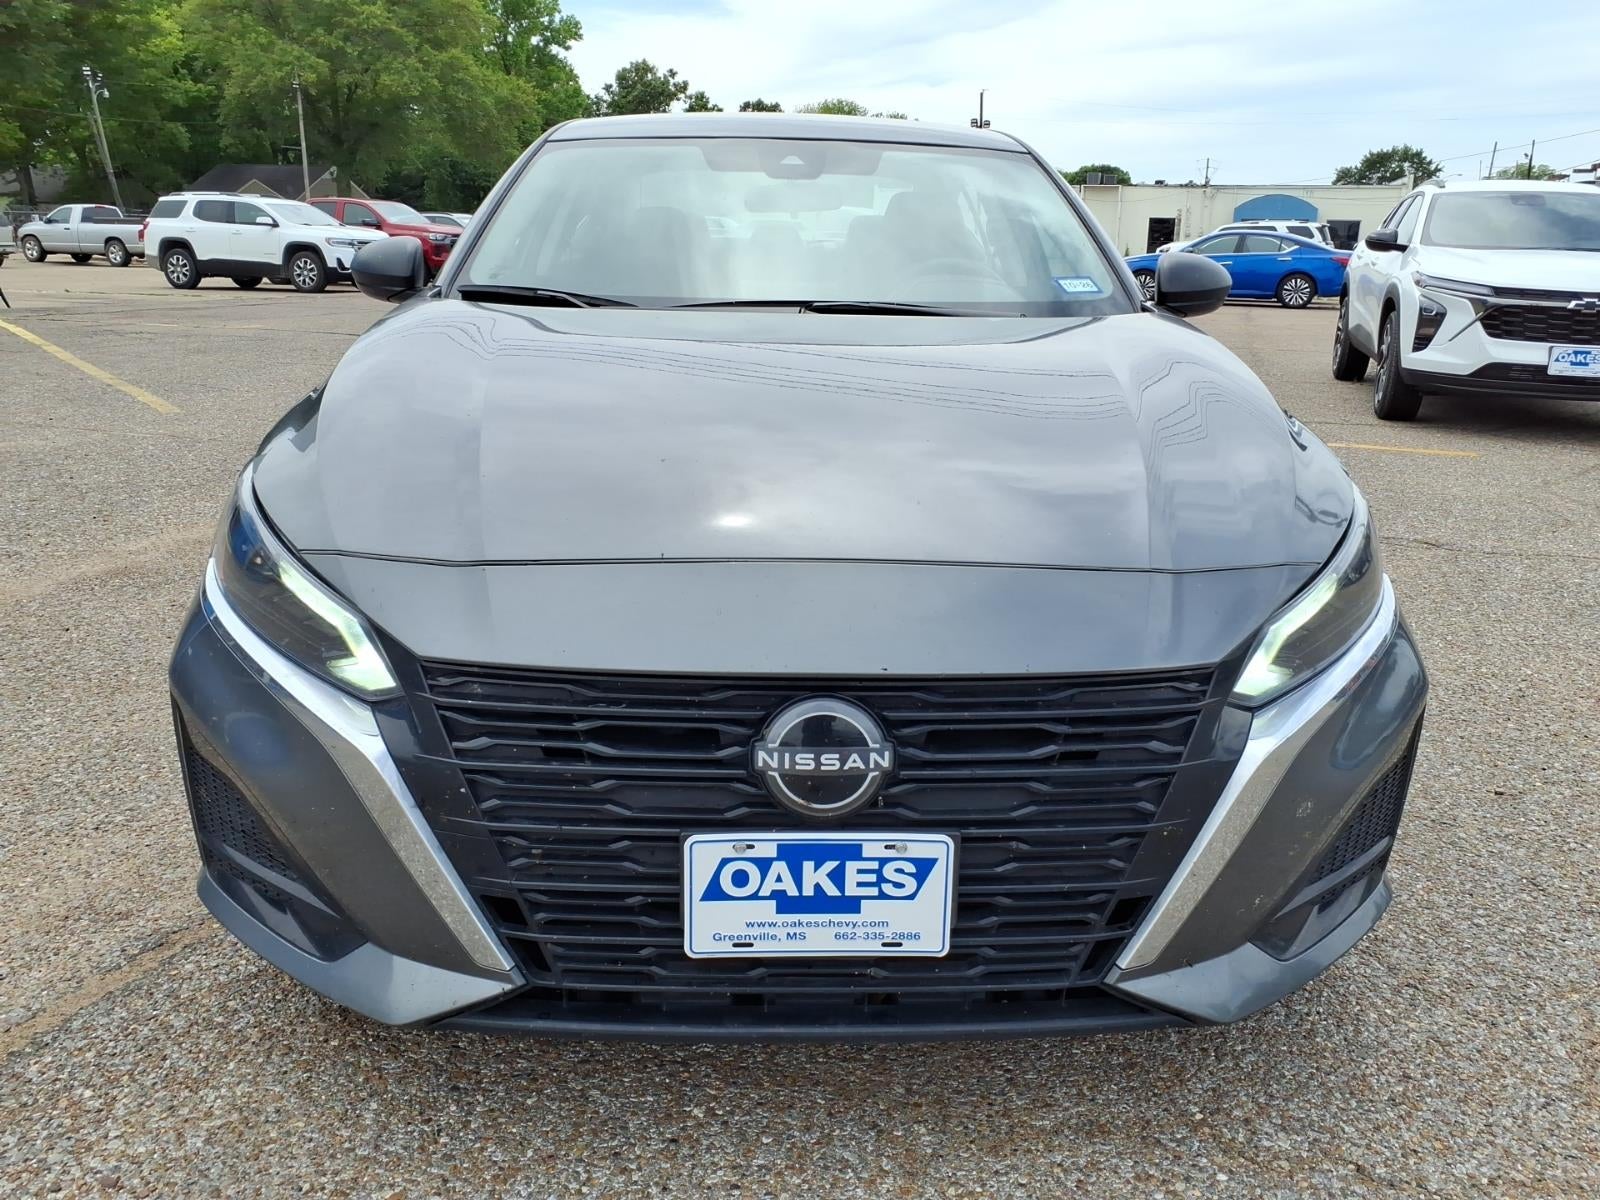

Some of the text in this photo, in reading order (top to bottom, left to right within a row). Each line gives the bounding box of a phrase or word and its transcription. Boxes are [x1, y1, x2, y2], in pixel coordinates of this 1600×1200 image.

[757, 750, 889, 770] NISSAN
[719, 860, 918, 897] OAKES
[745, 918, 889, 929] www.oakeschevy.com
[712, 931, 807, 943] Greenville, MS
[834, 931, 921, 941] 662-335-2886
